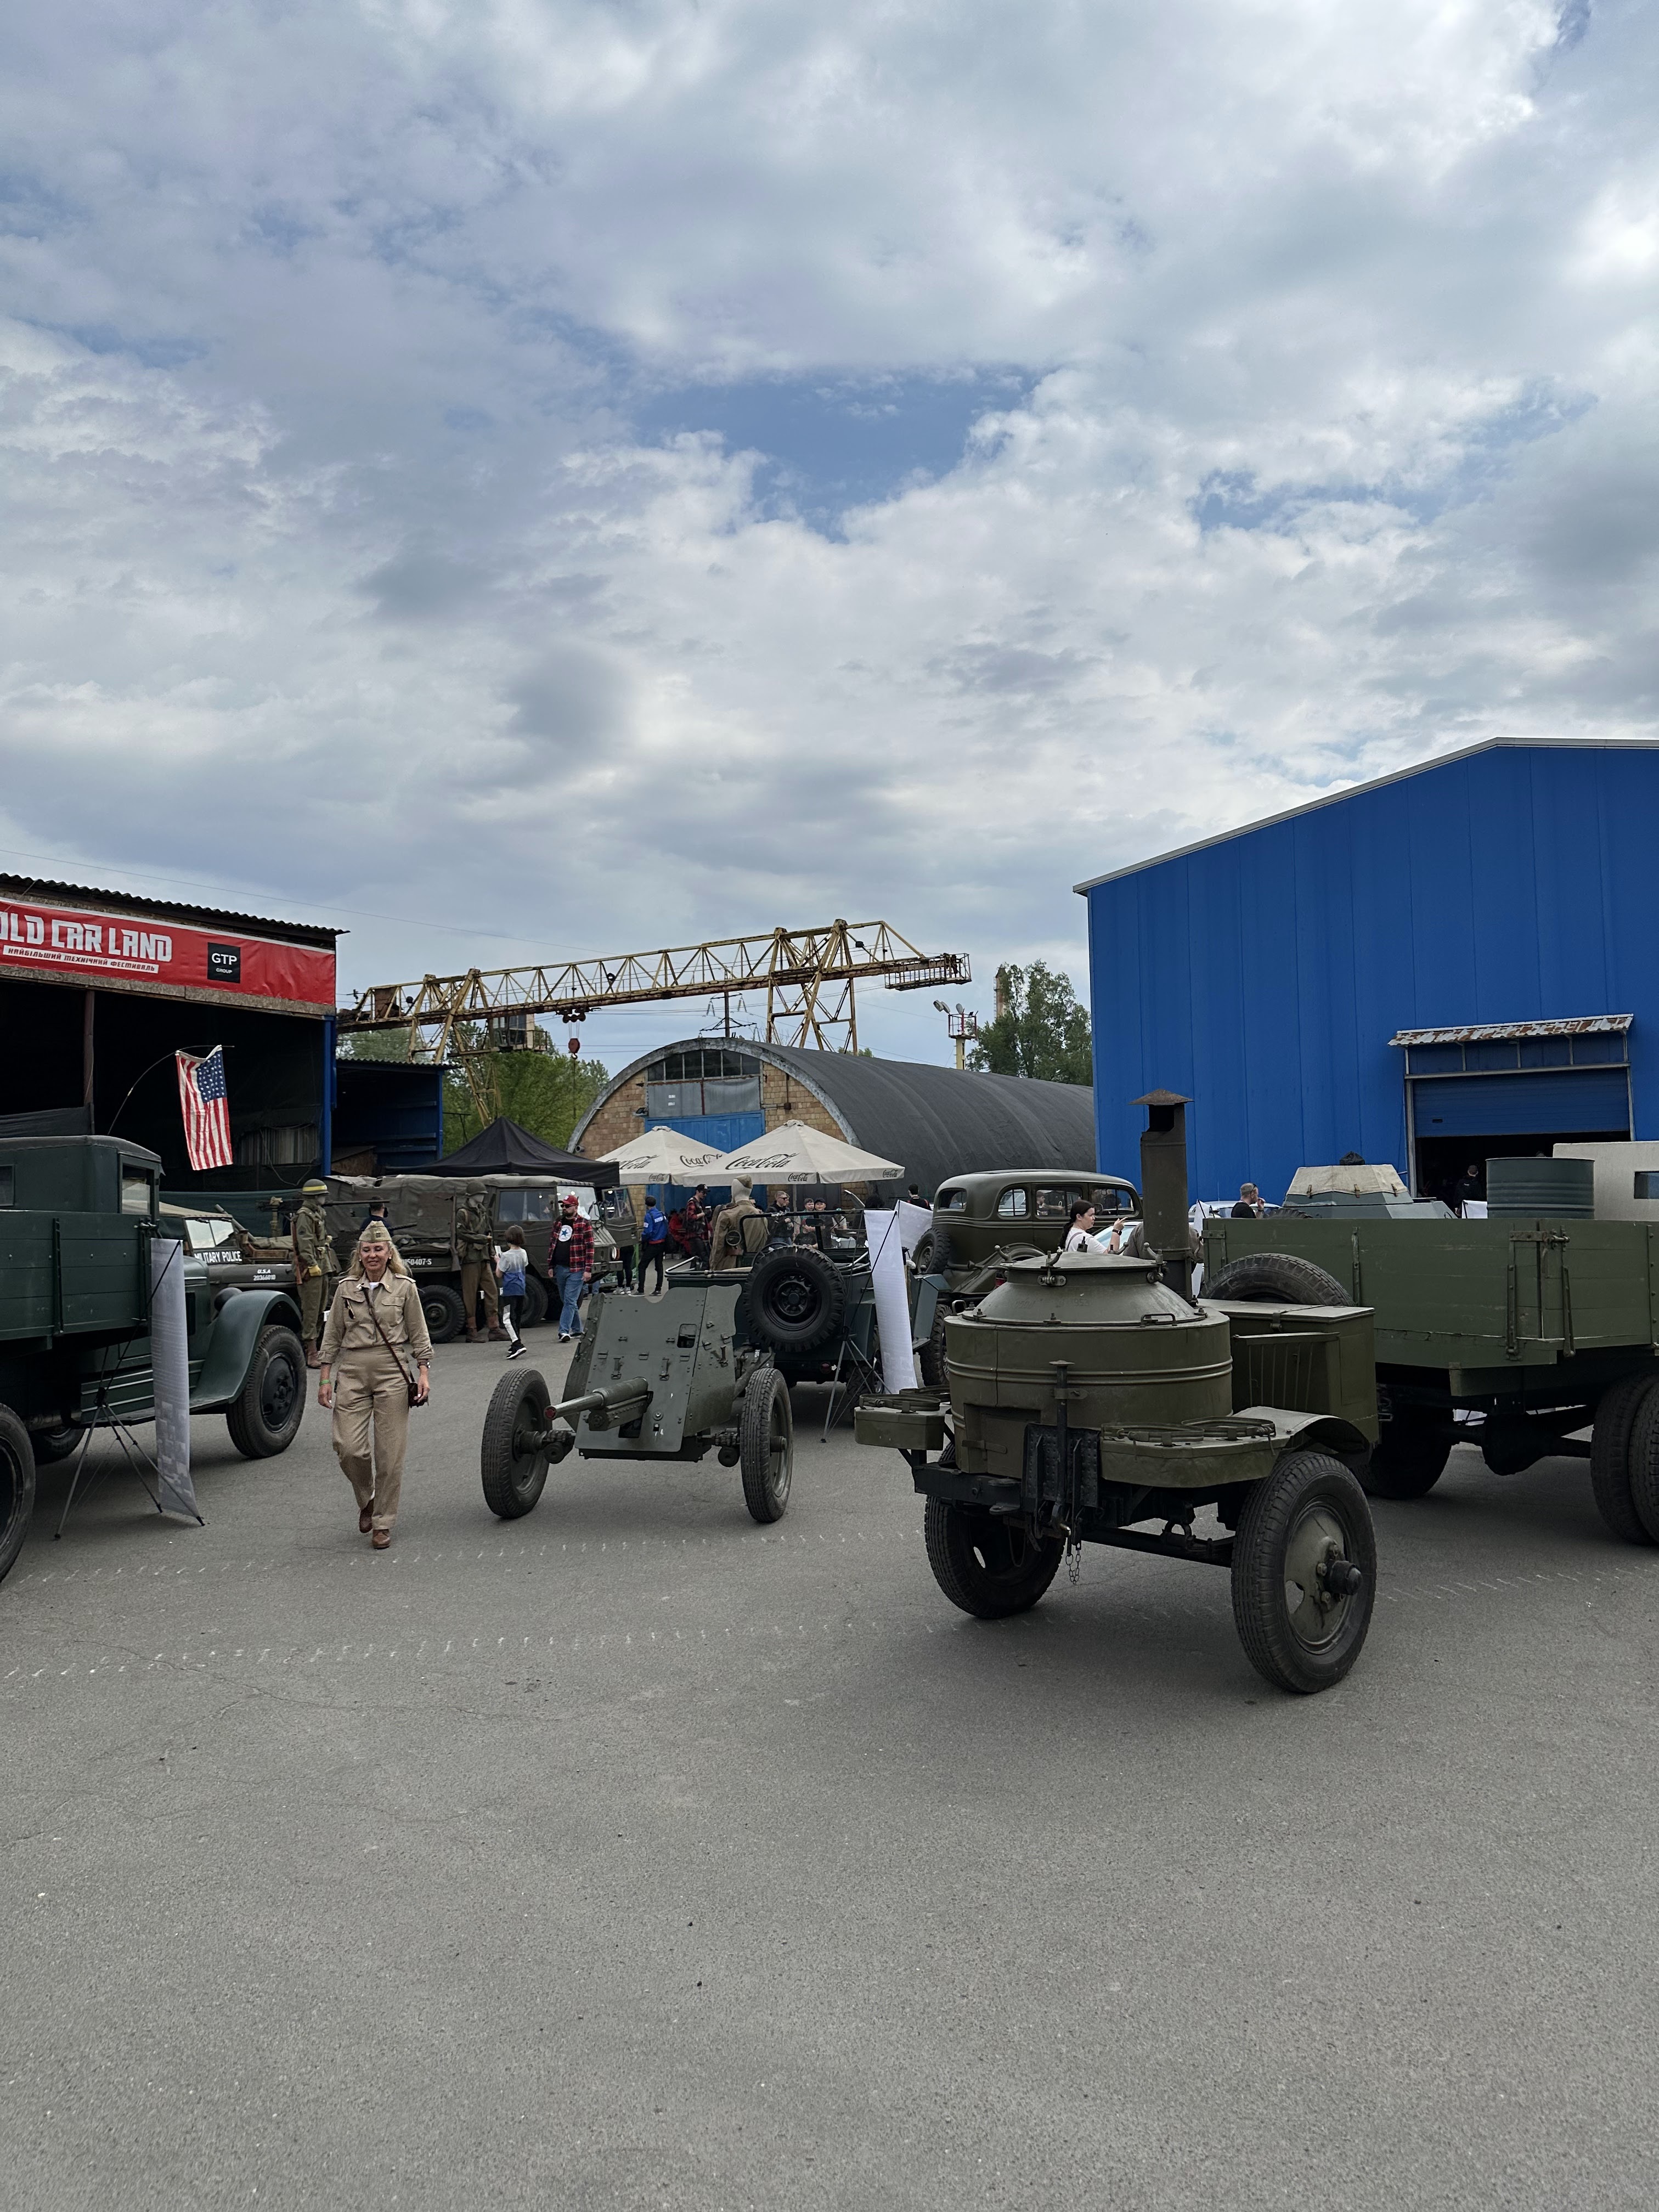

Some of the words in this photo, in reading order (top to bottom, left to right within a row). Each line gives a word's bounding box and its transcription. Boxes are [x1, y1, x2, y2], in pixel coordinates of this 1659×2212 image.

[52, 919, 102, 953] CAR
[109, 928, 172, 962] LAND
[8, 947, 61, 960] НАЙБІЛЬШИЙ
[64, 955, 108, 966] ТЕХНІЧНИЙ
[110, 961, 155, 971] ФЕСТИВАЛЬ
[211, 952, 238, 965] GTP
[221, 1251, 242, 1262] POLICE
